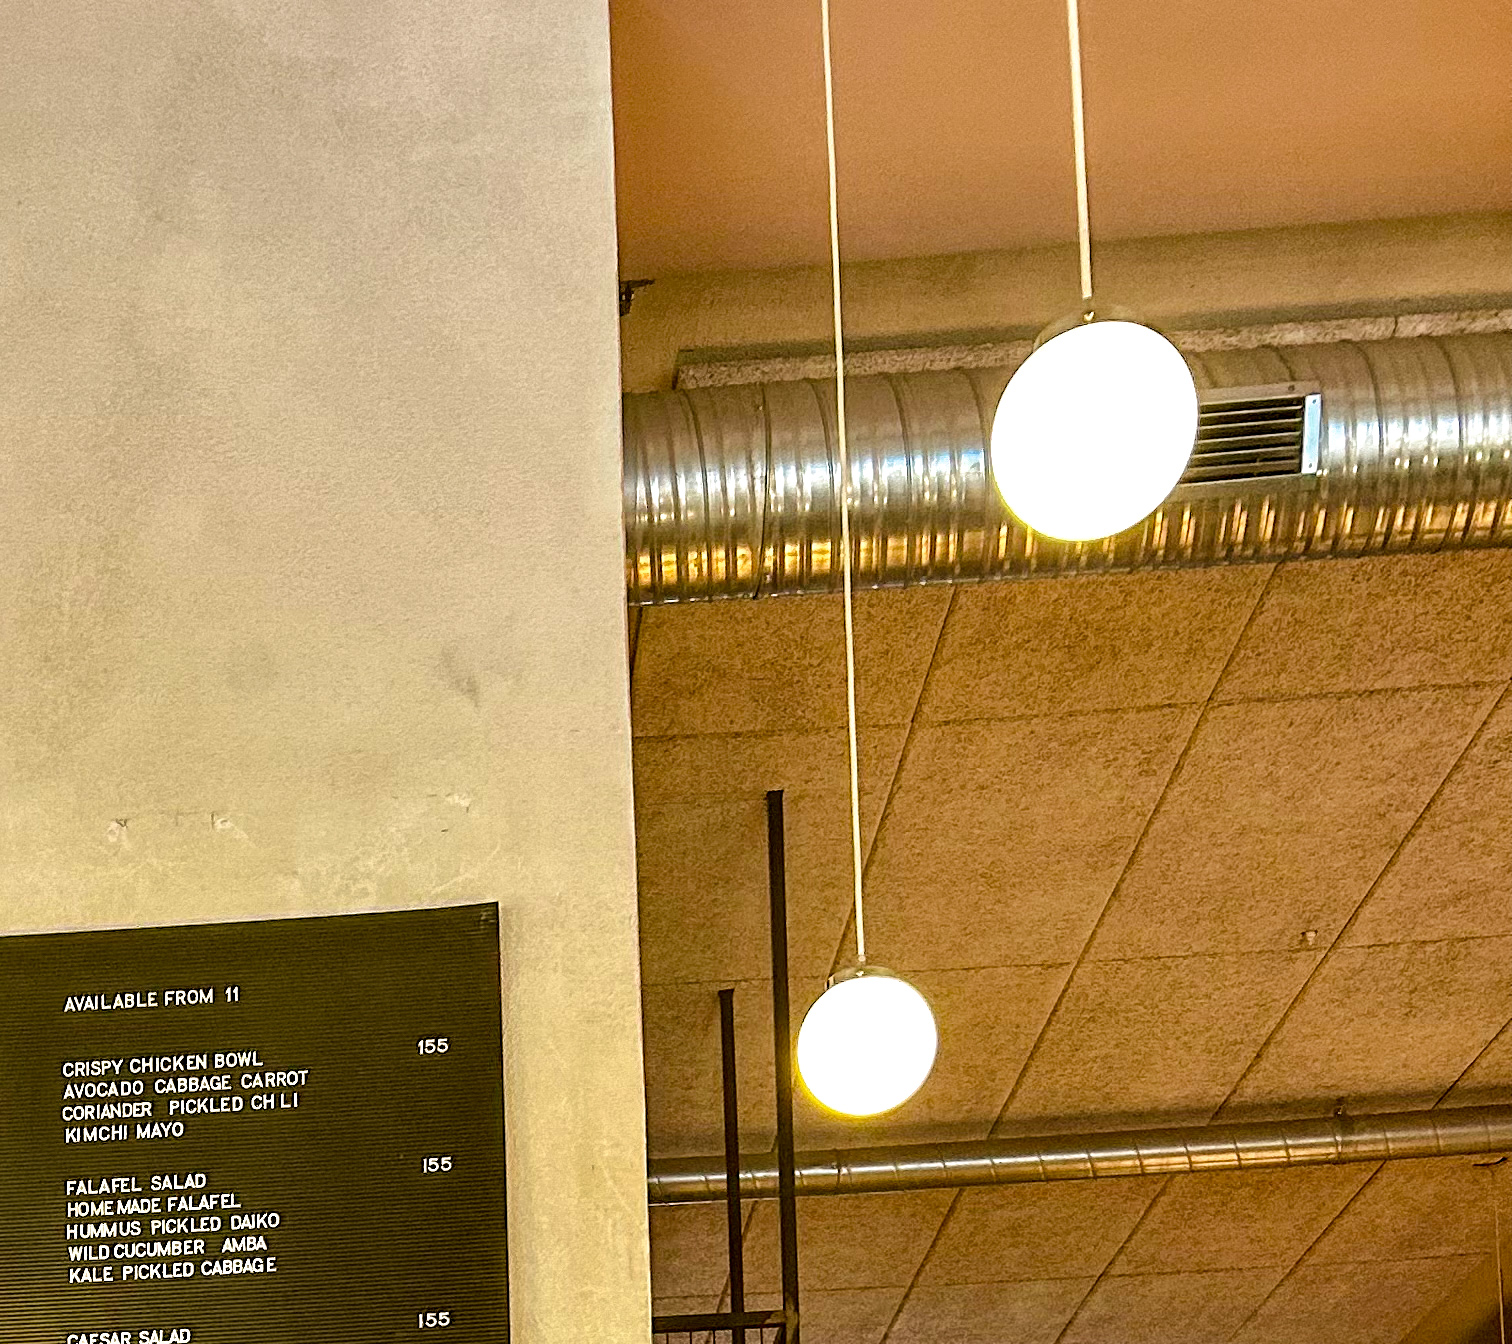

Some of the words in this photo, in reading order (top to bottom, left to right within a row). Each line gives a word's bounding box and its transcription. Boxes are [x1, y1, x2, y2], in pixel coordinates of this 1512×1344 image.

[64, 991, 158, 1013] AVAILABLE
[164, 988, 214, 1007] FROM
[225, 986, 239, 1002] 11
[418, 1038, 449, 1055] 155
[62, 1058, 124, 1078] CRISPY
[129, 1054, 207, 1074] CHICKEN
[214, 1051, 264, 1069] BOWL
[63, 1080, 144, 1100] AVOCADO
[154, 1074, 232, 1094] CABBAGE
[240, 1069, 309, 1089] CARROT
[65, 1124, 128, 1144] KIMCHI
[136, 1121, 184, 1139] MAYO
[423, 1156, 452, 1174] 155
[66, 1176, 142, 1196] FALAFEL
[150, 1173, 207, 1191] SALAD
[67, 1197, 162, 1218] HOMEMADE
[167, 1193, 242, 1212] FALAFEL
[418, 1311, 450, 1329] 155
